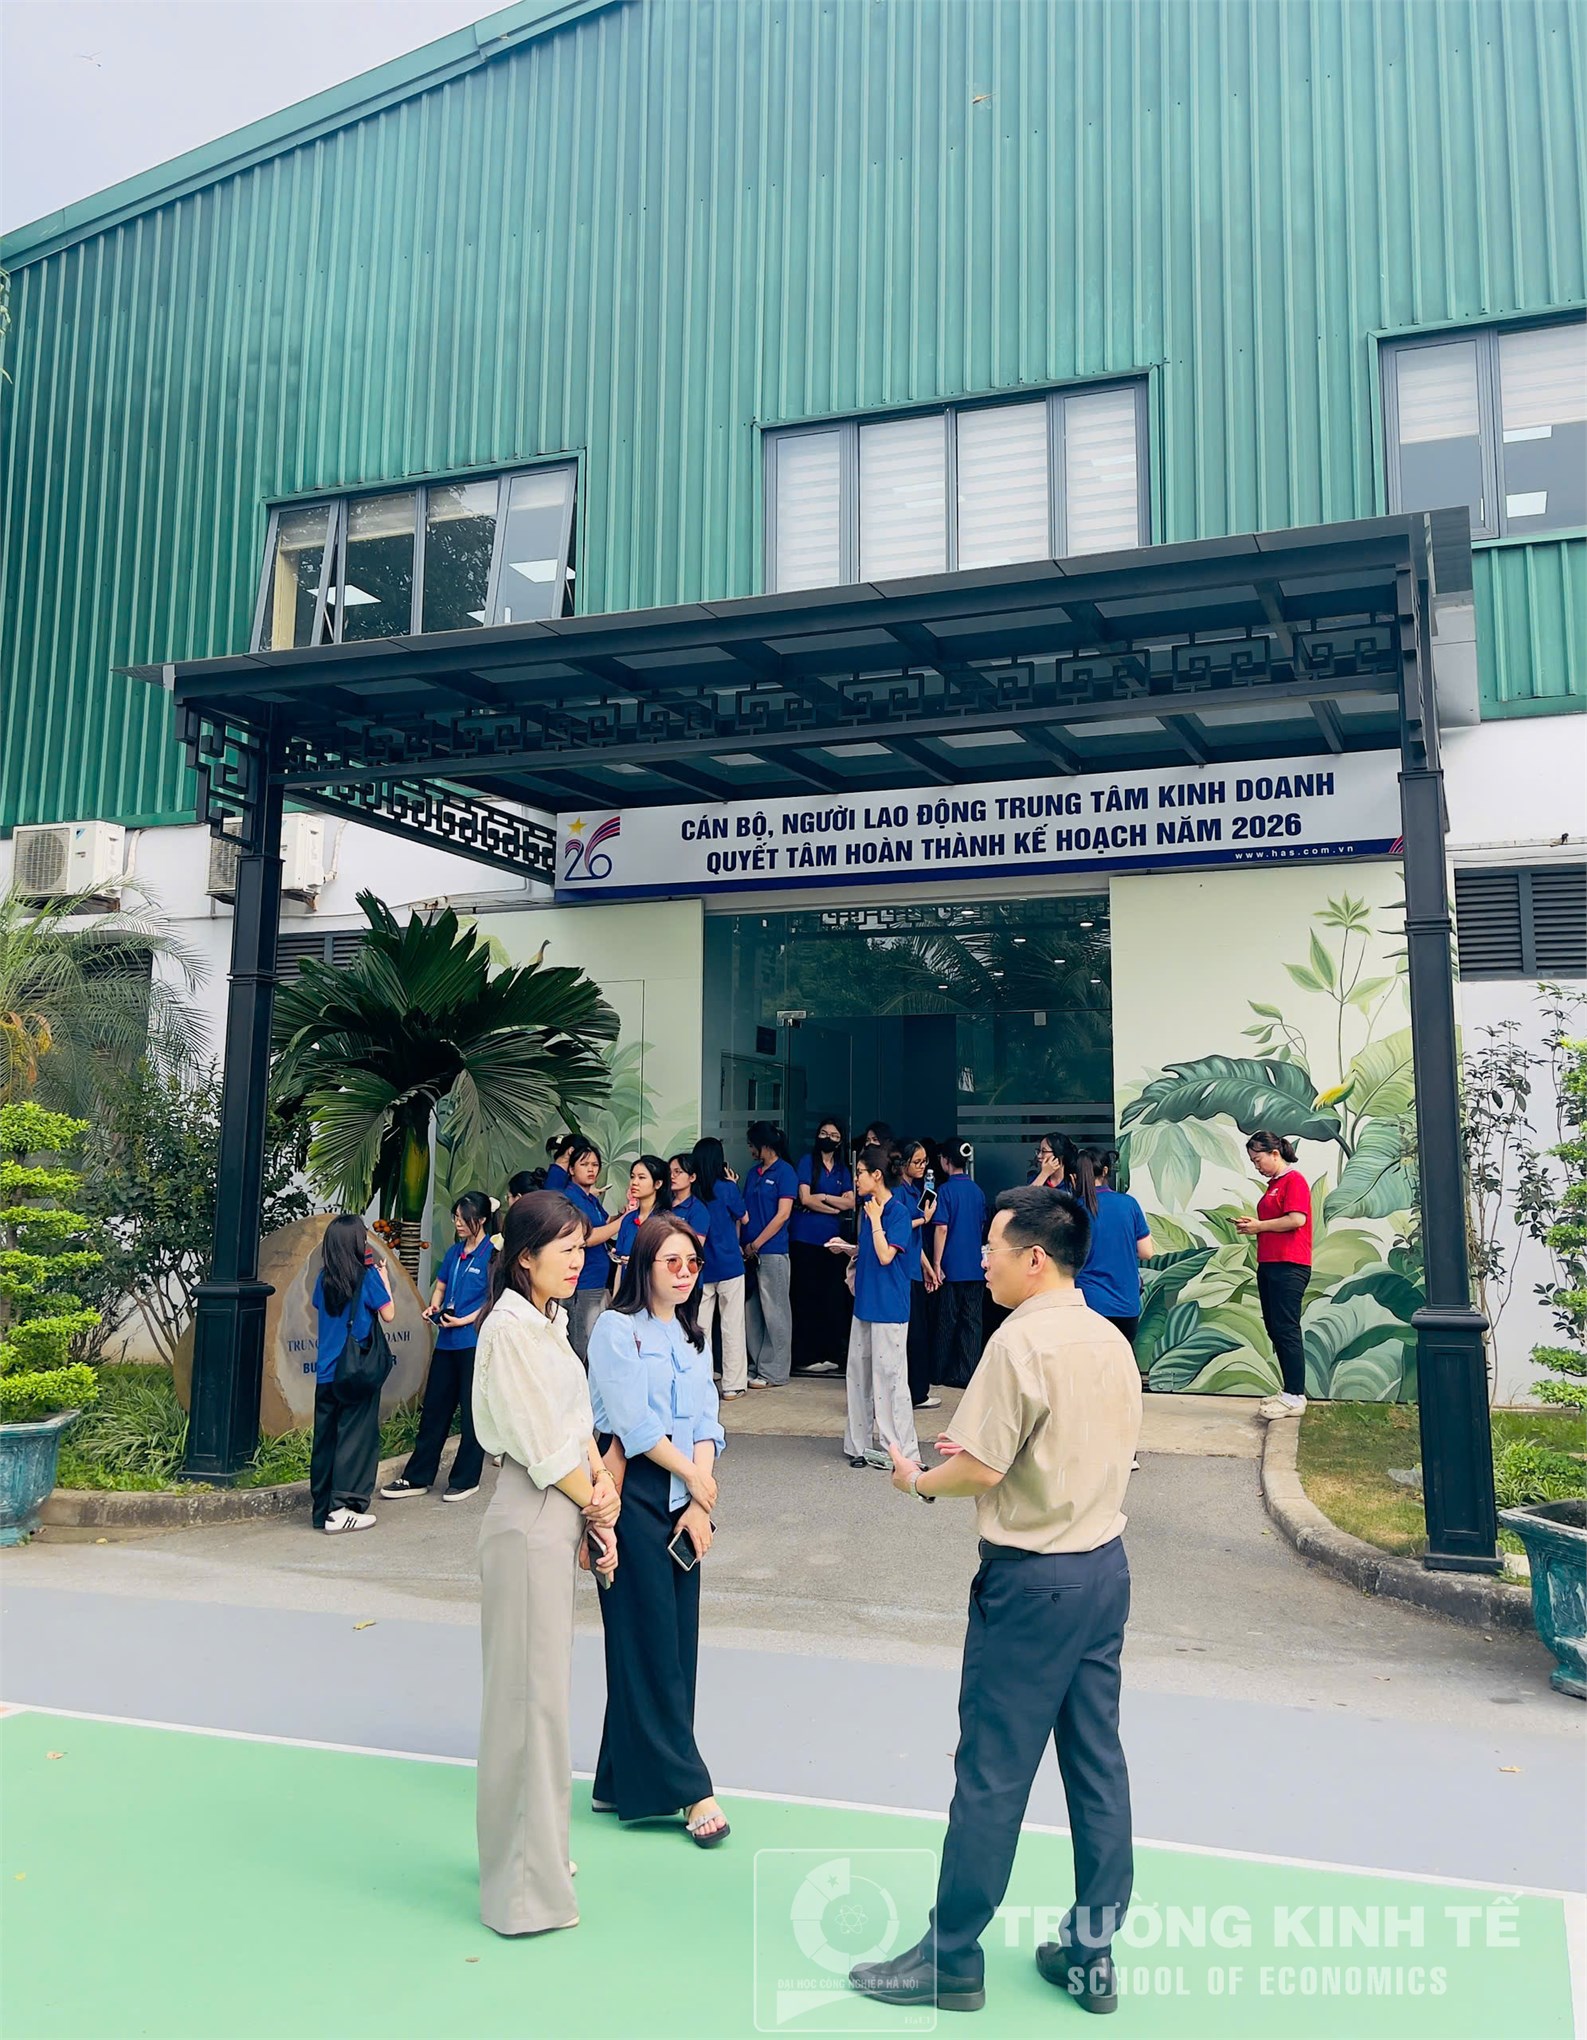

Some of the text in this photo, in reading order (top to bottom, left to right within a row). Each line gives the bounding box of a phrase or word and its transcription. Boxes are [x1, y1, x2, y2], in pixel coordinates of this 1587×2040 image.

[681, 772, 1335, 842] CÁN BỘ, NGƯỜI LAO ĐỘNG TRUNG TÂM KINH DOANH
[706, 812, 1302, 875] QUYẾT TÂM HOÀN THÀNH KẾ HOẠCH NĂM 2026
[1235, 845, 1354, 860] www.has.com.vn
